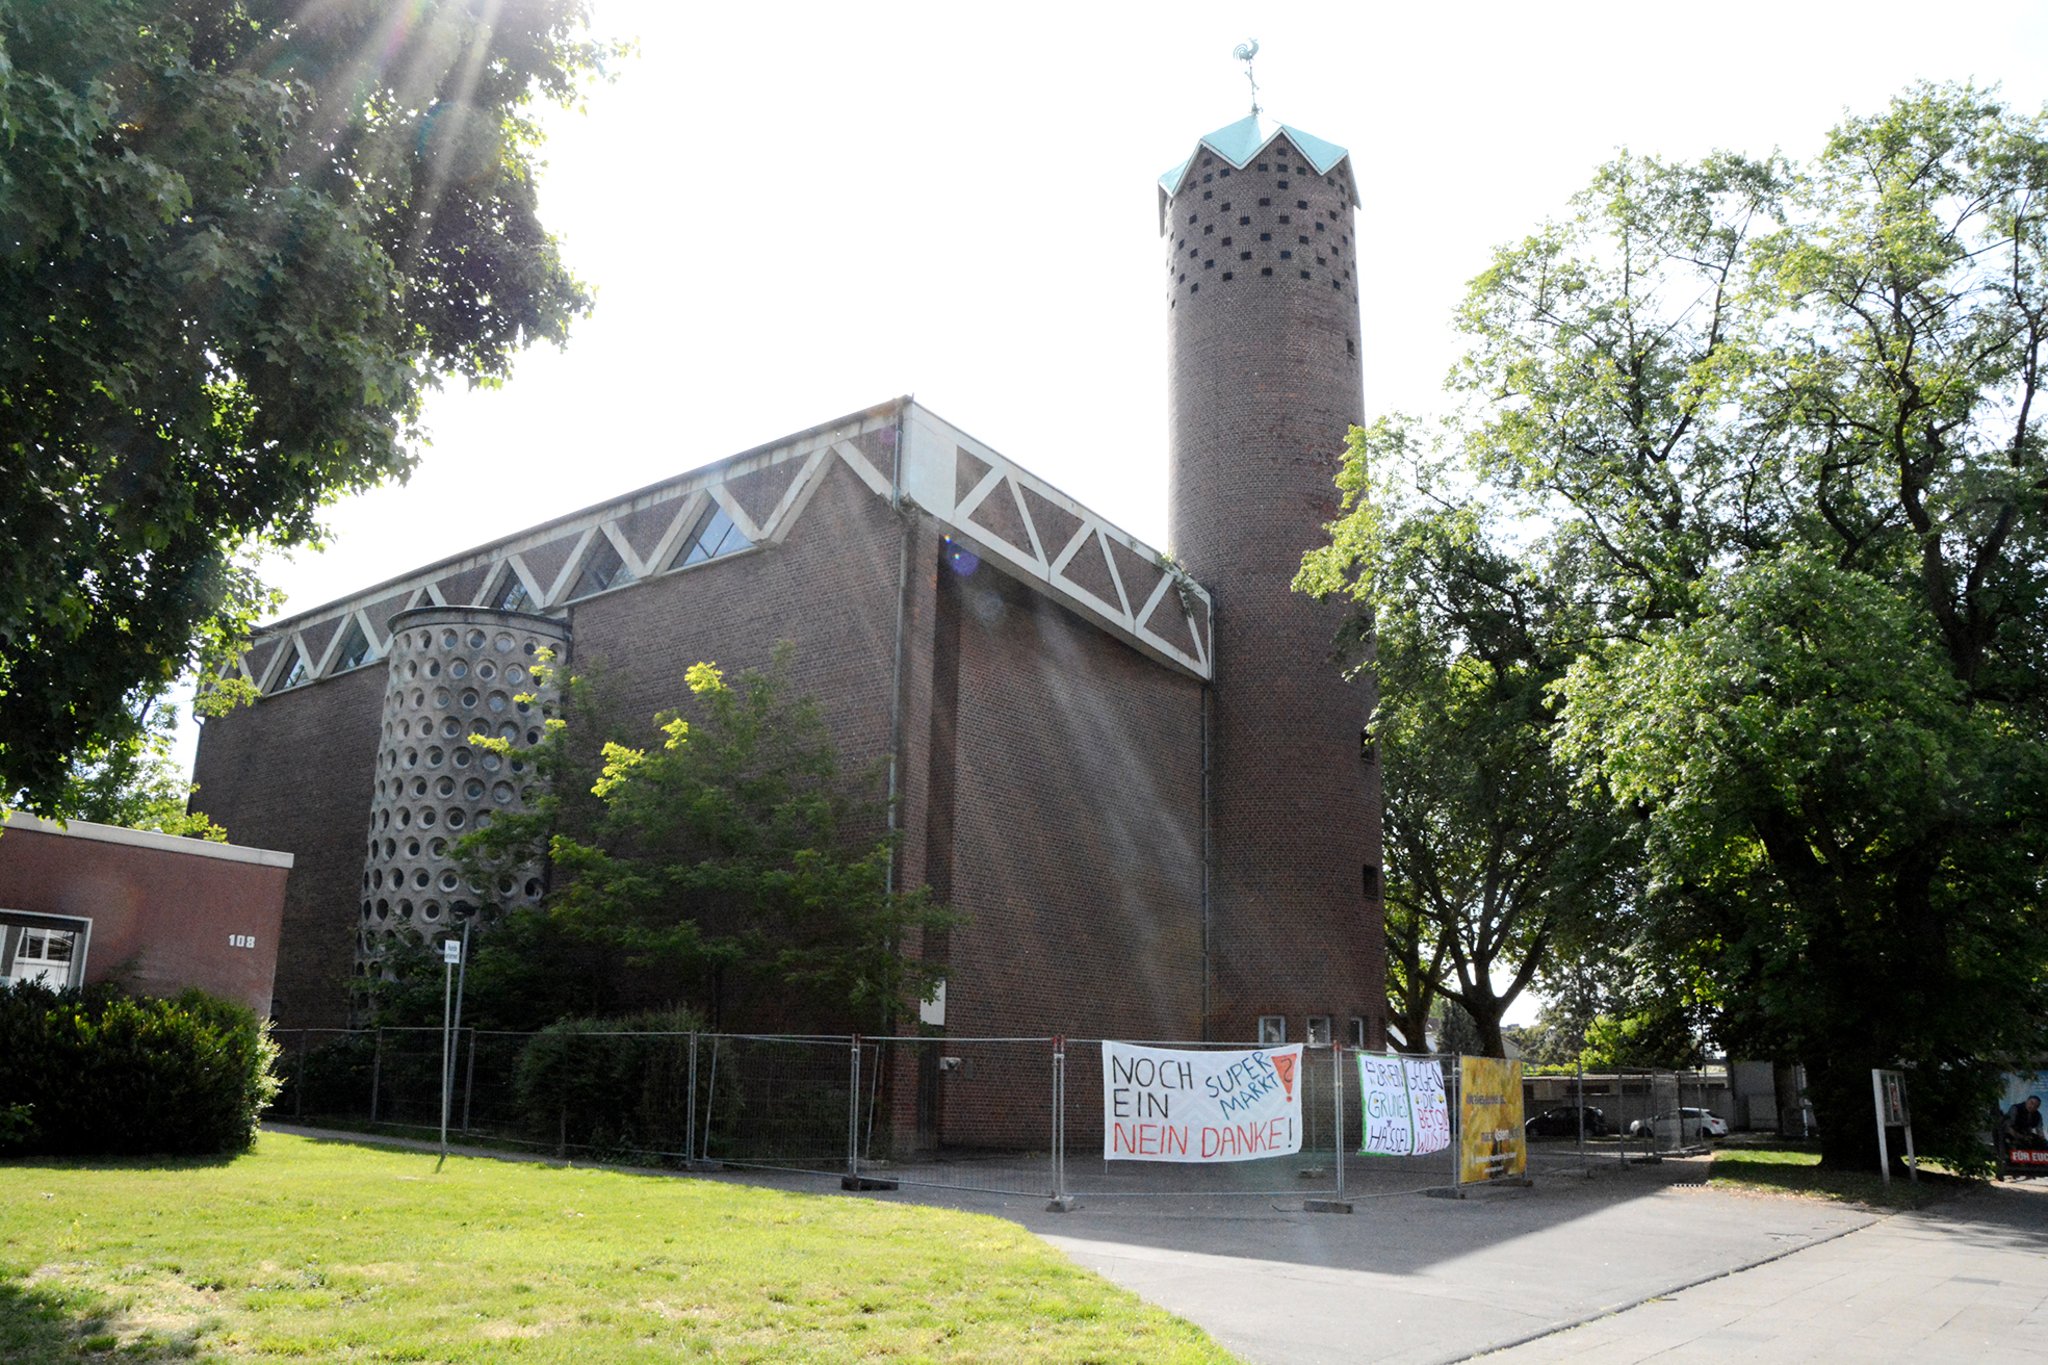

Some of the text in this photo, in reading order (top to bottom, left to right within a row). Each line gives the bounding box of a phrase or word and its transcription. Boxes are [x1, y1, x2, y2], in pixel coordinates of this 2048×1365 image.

[228, 933, 256, 949] 108
[1112, 1054, 1193, 1090] NOCH
[1405, 1060, 1444, 1092] GEGEN
[1113, 1088, 1168, 1118] EIN
[1219, 1072, 1279, 1120] MARKT
[1417, 1108, 1448, 1129] BETON
[1113, 1122, 1188, 1155] NEIN
[1367, 1125, 1409, 1152] HASSEL
